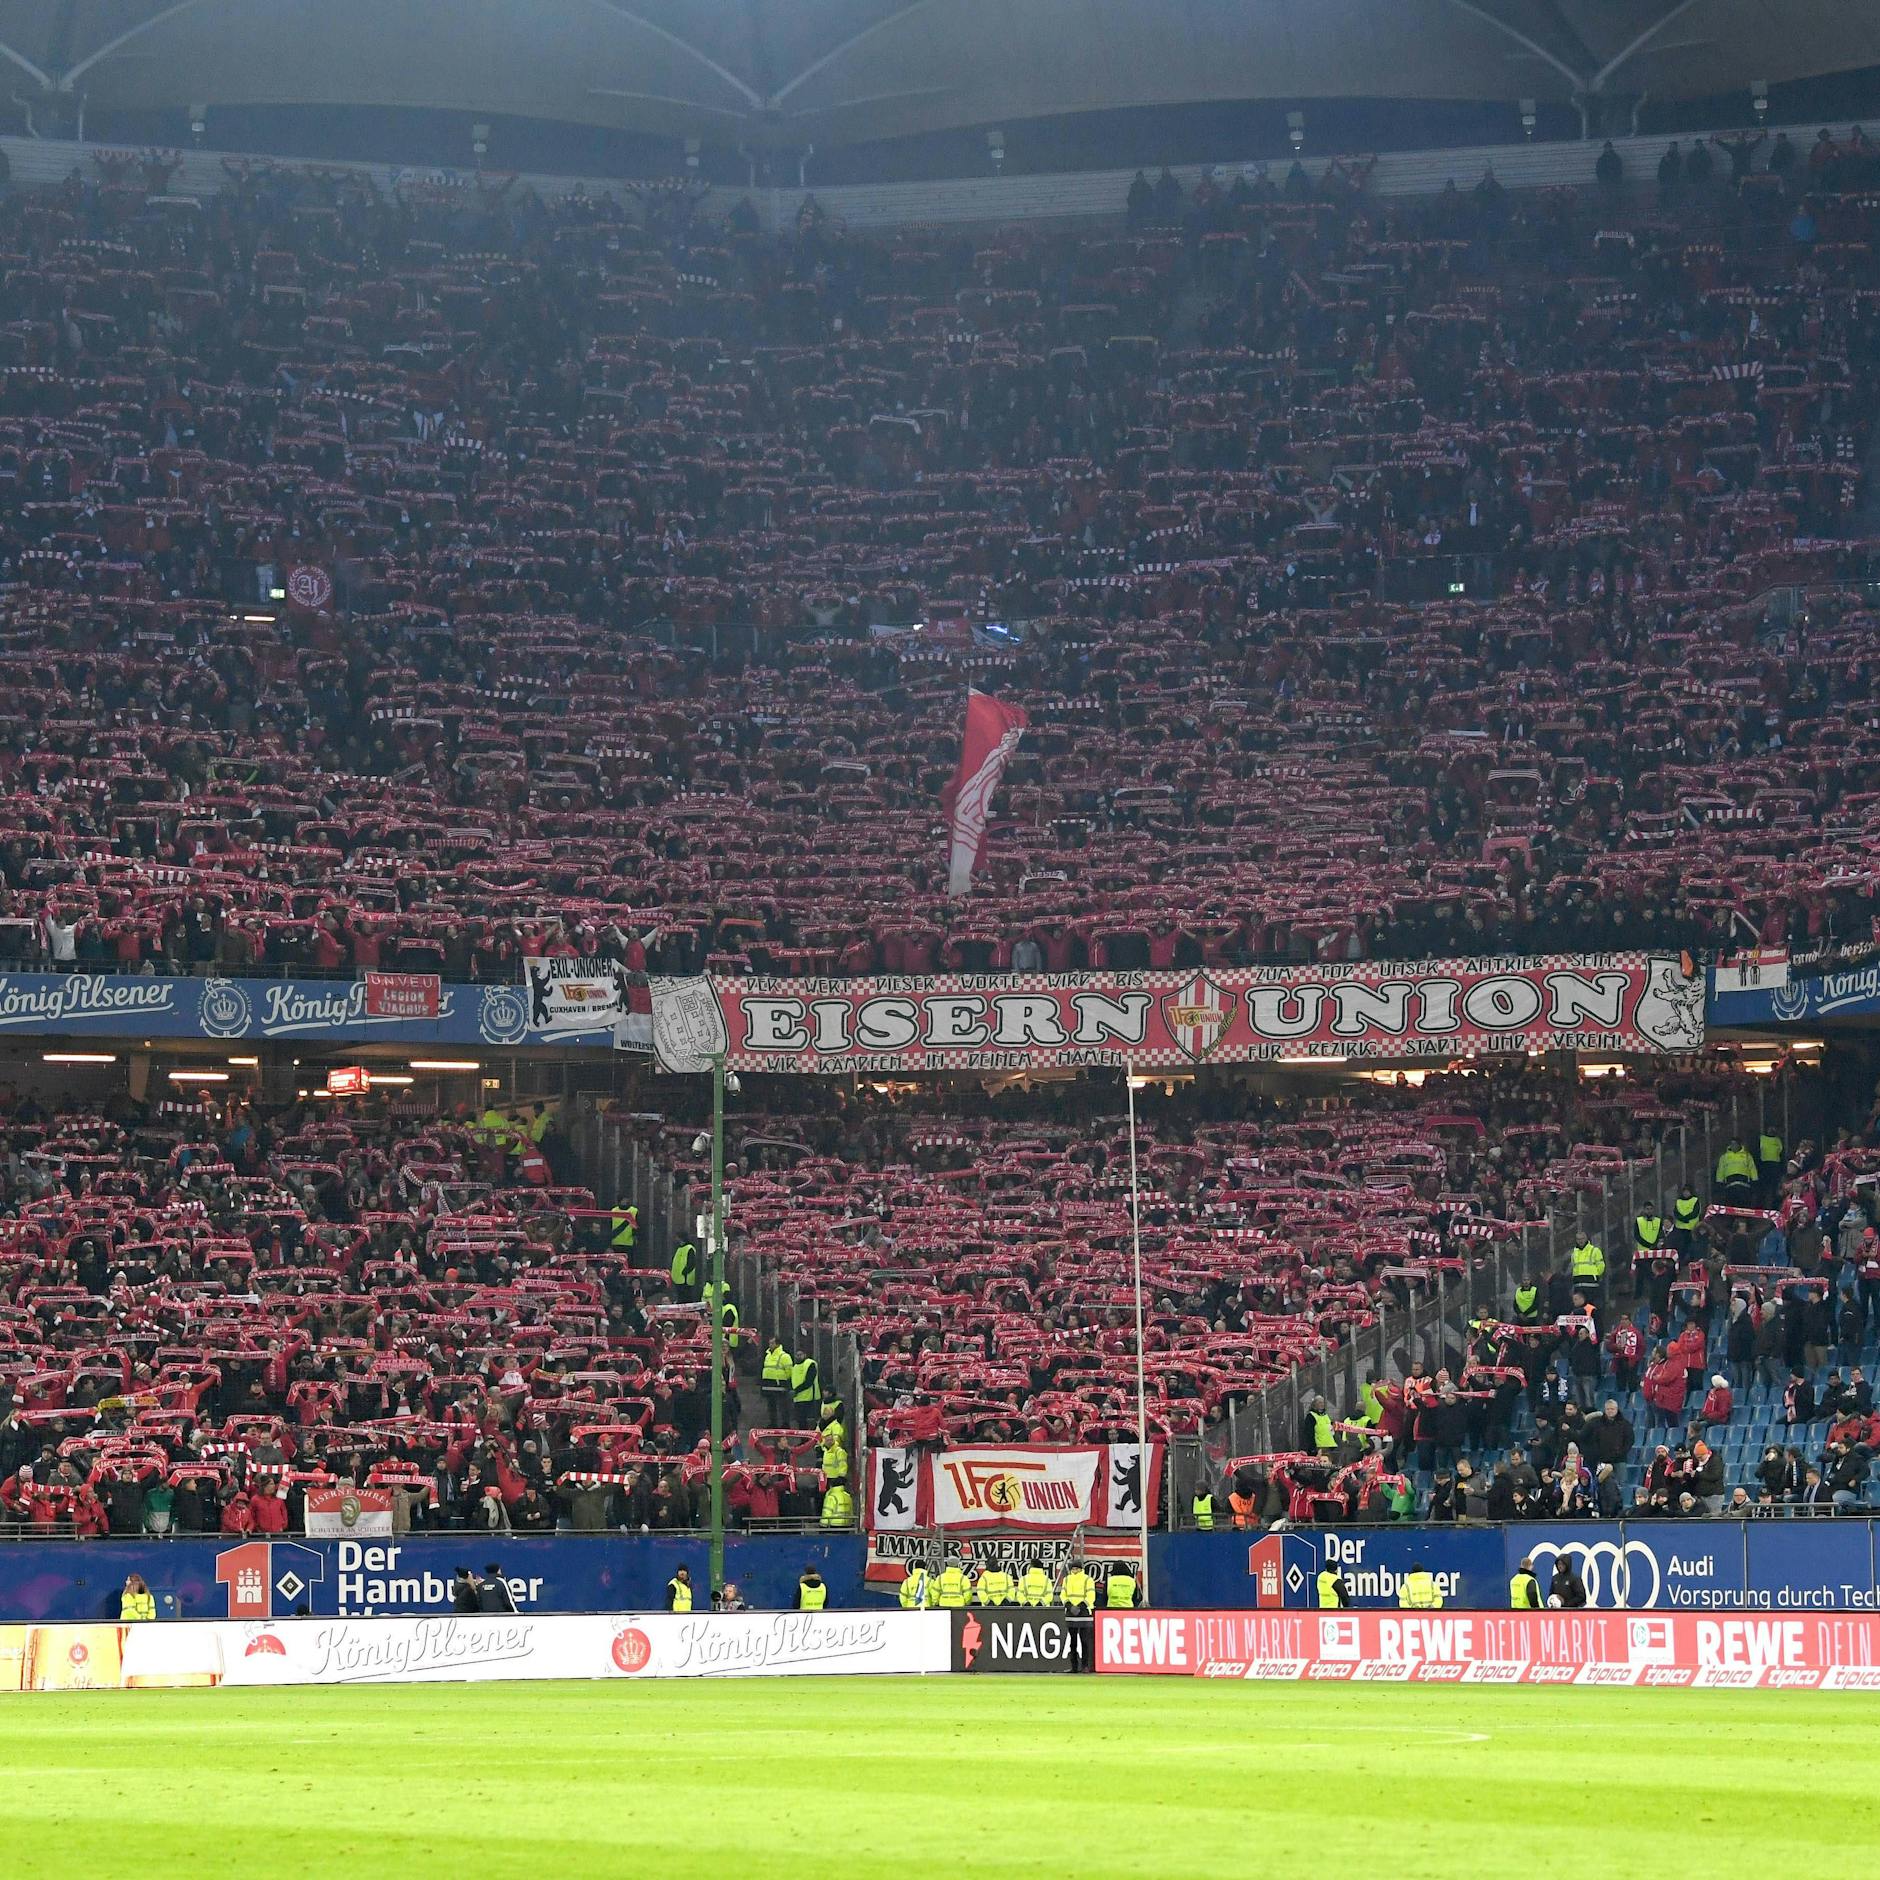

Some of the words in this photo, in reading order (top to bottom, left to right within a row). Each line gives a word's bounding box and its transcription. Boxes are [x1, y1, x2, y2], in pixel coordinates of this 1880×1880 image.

[550, 958, 613, 979] EXIL-UNIONER
[746, 978, 780, 992] DER
[804, 978, 850, 994] WERT
[876, 976, 936, 991] DIESER
[961, 974, 1021, 989] WORTE
[1047, 973, 1092, 988] WIRD
[1115, 971, 1144, 986] BIS
[1256, 967, 1293, 981] ZUM
[1320, 965, 1354, 978] TOD
[1379, 961, 1439, 977] UNSER
[1465, 955, 1544, 973] ANTRIEB
[0, 978, 63, 1020] önig
[64, 973, 174, 1010] Pilsener
[261, 985, 348, 1026] König
[383, 988, 425, 1002] LEGION
[550, 1005, 586, 1014] CUXHAVEN
[740, 992, 1155, 1054] EISERN
[1244, 971, 1632, 1041] UNION
[1200, 1012, 1222, 1023] UNION
[766, 1056, 798, 1071] WIR
[818, 1055, 901, 1073] KÄMPFEN
[926, 1053, 945, 1069] IN
[967, 1052, 1032, 1067] DEINEM
[1056, 1049, 1123, 1066] NAMEN
[1405, 1038, 1461, 1054] STADT
[1488, 1033, 1526, 1050] UND
[1552, 1032, 1622, 1049] VEREIN!
[310, 1489, 353, 1509] EISERNE
[355, 1488, 392, 1509] OHREN
[1021, 1480, 1080, 1511] UNION
[338, 1541, 402, 1572] Der
[876, 1533, 962, 1561] IMMER
[968, 1538, 1074, 1562] WEITER
[1324, 1532, 1366, 1564] Der
[999, 1557, 1057, 1584] ACH
[1334, 1564, 1461, 1598] ambuer
[1667, 1555, 1714, 1577] Audi
[338, 1570, 544, 1604] Hambuer
[1667, 1584, 1771, 1610] Vorsprung
[1777, 1585, 1835, 1607] durch
[312, 1625, 411, 1675] König
[411, 1618, 534, 1663] Pilsener
[675, 1620, 769, 1669] König
[769, 1613, 886, 1657] Pilsener
[1102, 1617, 1187, 1666] REWE
[1195, 1617, 1237, 1664] DEIN
[1243, 1617, 1302, 1660] MARKT
[1379, 1618, 1474, 1663] REWE
[1484, 1619, 1531, 1662] DEIN
[1539, 1619, 1608, 1663] MARKT
[1696, 1620, 1807, 1667] REWE
[1817, 1622, 1872, 1667] DEIN
[1204, 1658, 1247, 1678] tipico
[1255, 1658, 1297, 1680] tipico
[1308, 1660, 1353, 1680] tipico
[1362, 1659, 1407, 1681] tipico
[1417, 1661, 1462, 1681] tipico
[1473, 1661, 1518, 1683] tipico
[1528, 1662, 1575, 1683] tipico
[1586, 1663, 1633, 1685] tipico
[1644, 1664, 1692, 1686] tipico
[1705, 1665, 1752, 1688] tipico
[1768, 1666, 1820, 1688] tipico
